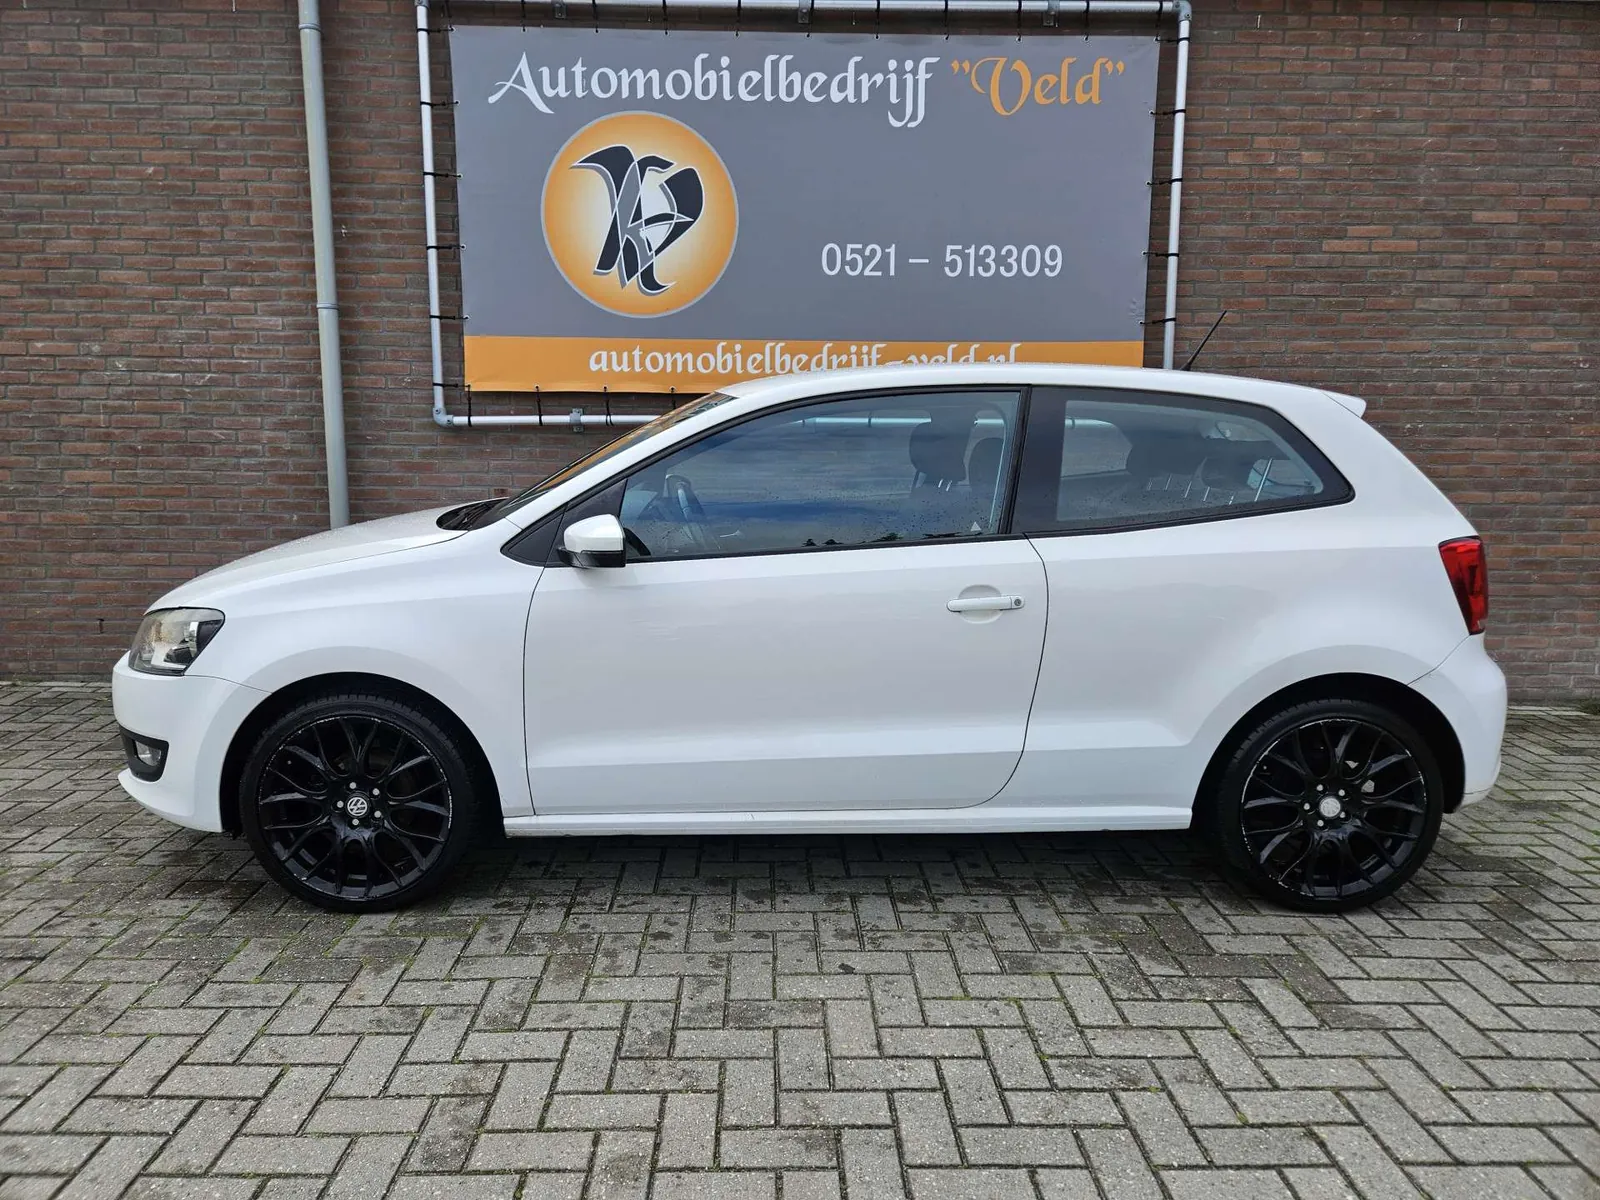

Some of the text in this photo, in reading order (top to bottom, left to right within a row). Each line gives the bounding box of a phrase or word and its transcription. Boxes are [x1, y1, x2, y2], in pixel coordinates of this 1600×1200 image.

[487, 51, 941, 128] Automobielbedrijf
[821, 242, 896, 276] 0521
[943, 244, 1063, 278] 513309
[589, 341, 1021, 374] automobielbedrijf-ldl
